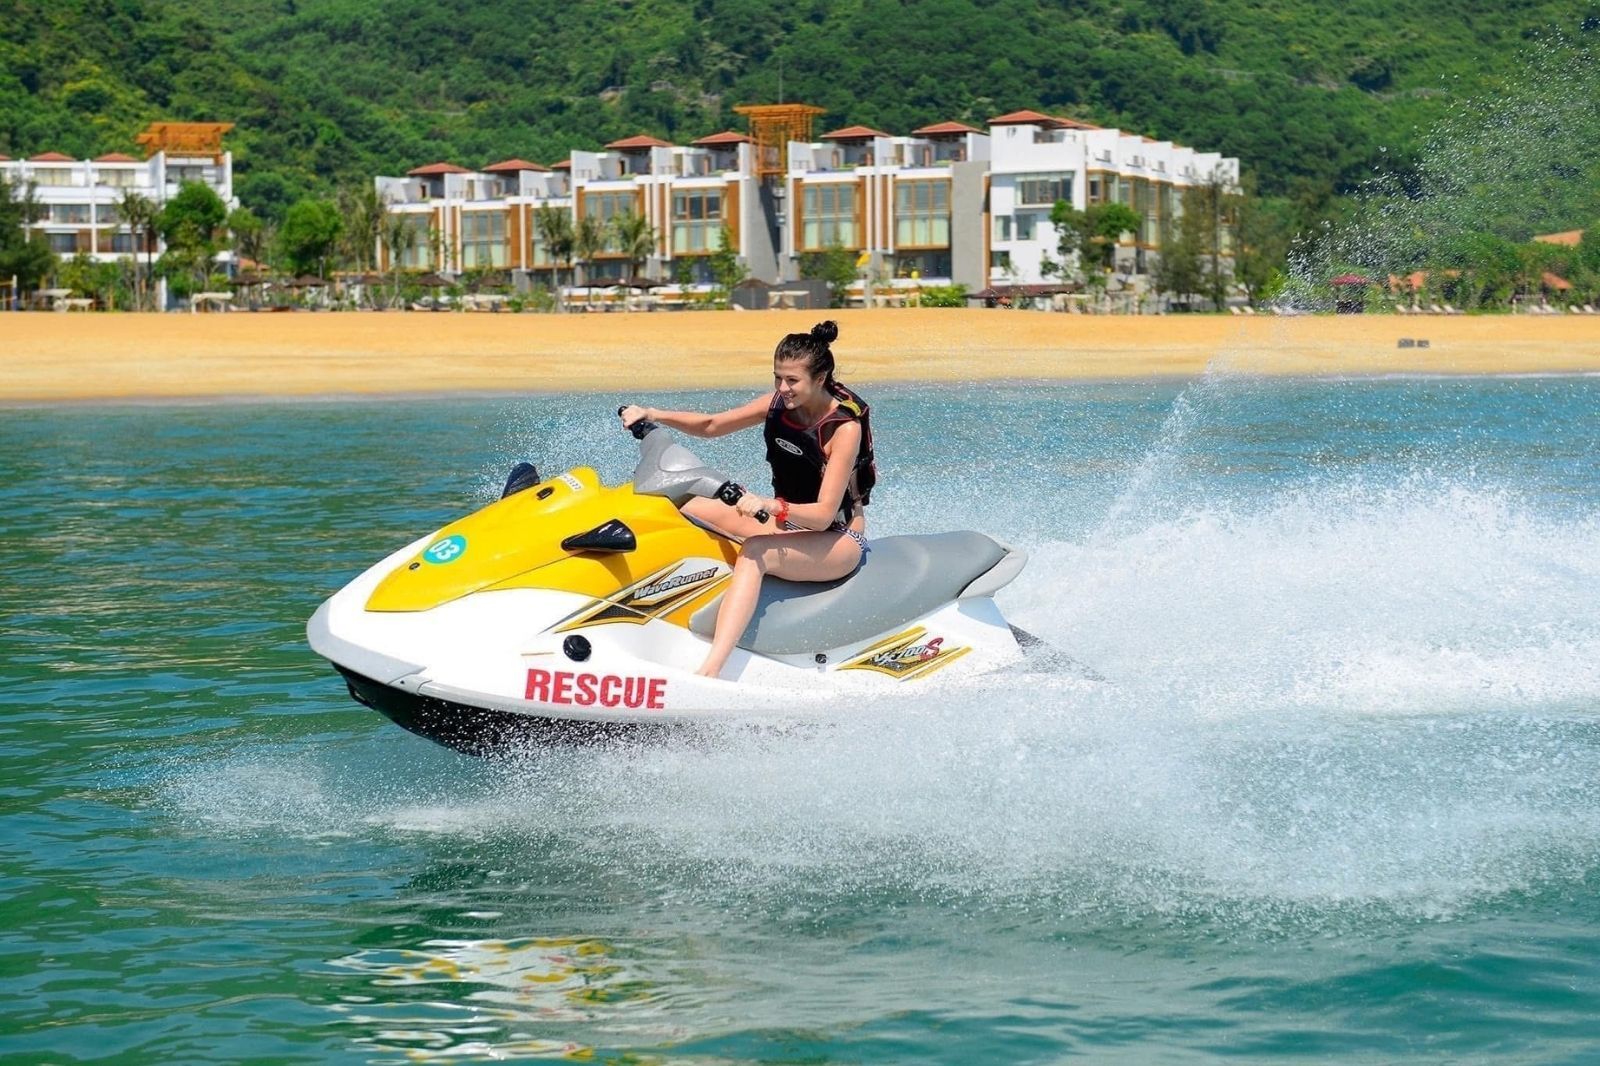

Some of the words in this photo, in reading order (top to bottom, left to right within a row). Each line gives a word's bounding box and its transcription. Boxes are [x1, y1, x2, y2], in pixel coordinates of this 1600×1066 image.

[428, 539, 460, 560] 03
[634, 567, 719, 599] WaveRunner
[525, 668, 667, 709] RESCUE
